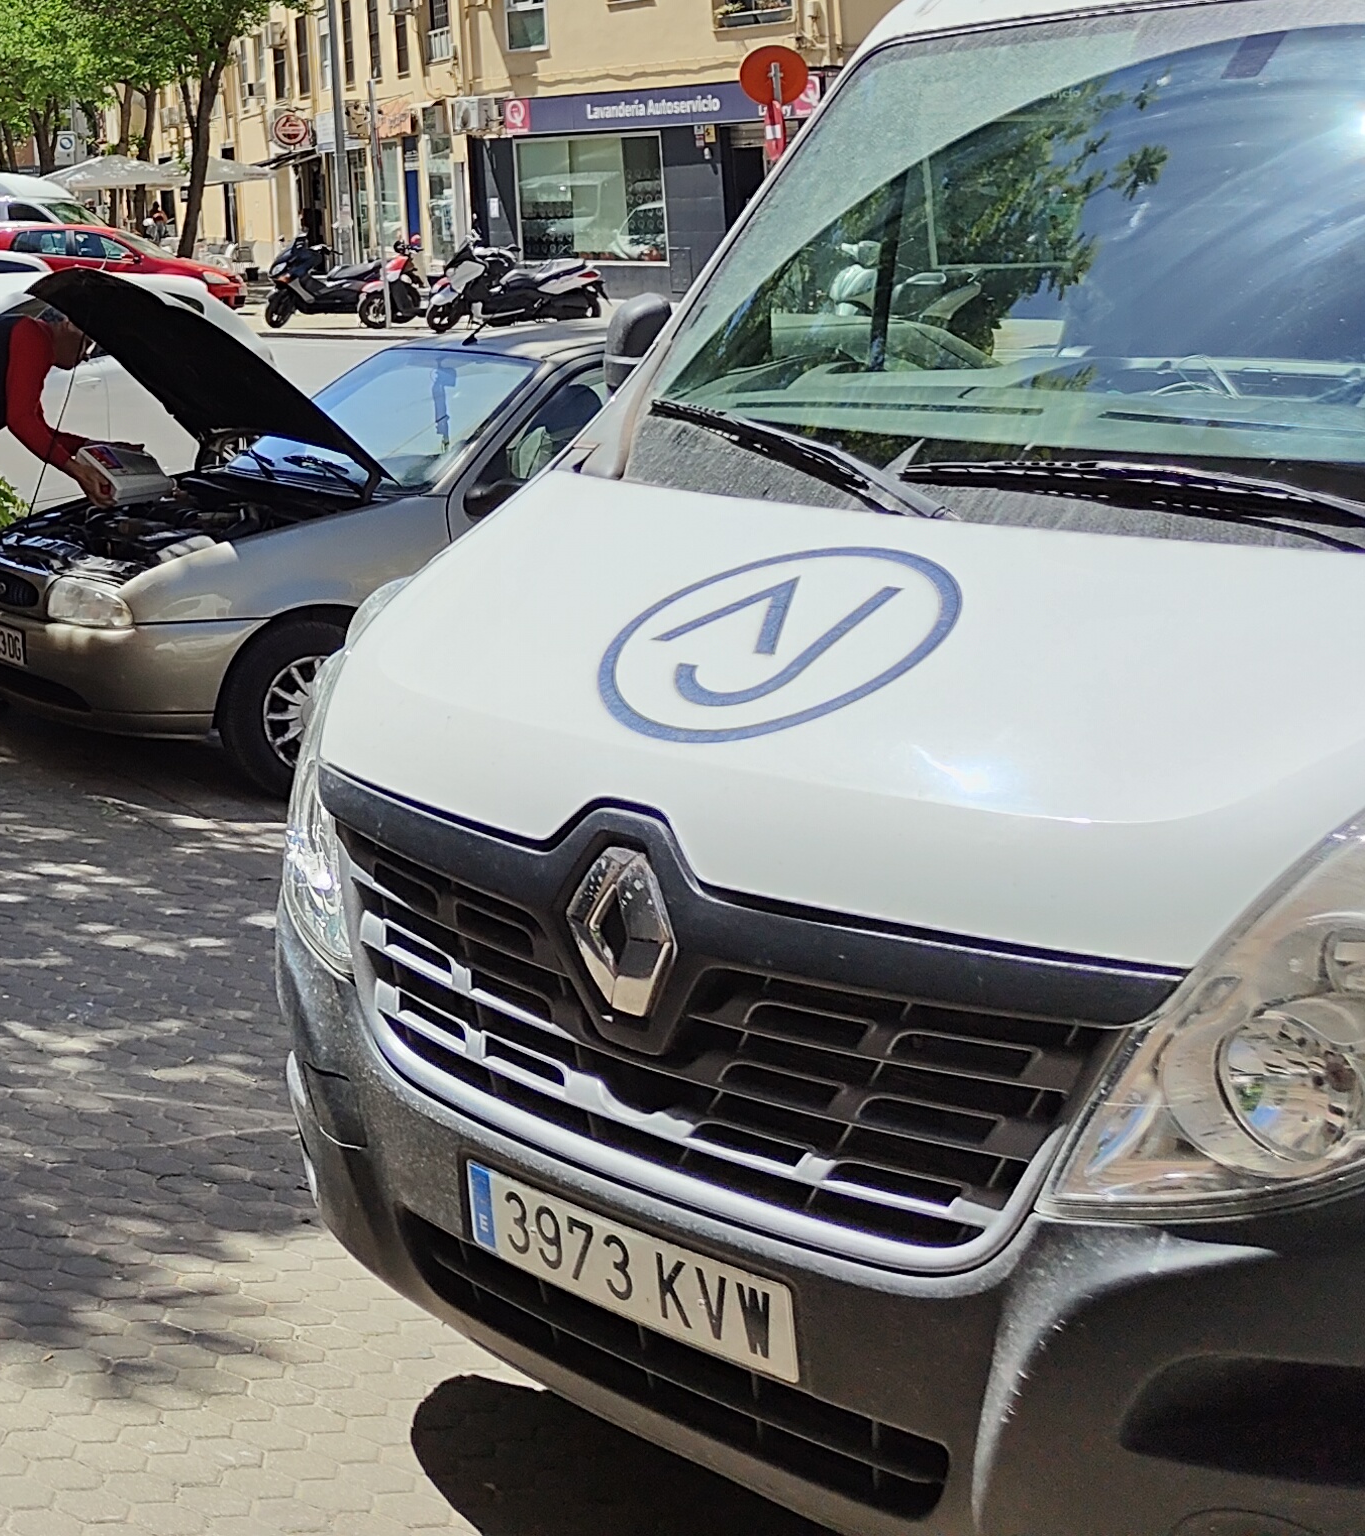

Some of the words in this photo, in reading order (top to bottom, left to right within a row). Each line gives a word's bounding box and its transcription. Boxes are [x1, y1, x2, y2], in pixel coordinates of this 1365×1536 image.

[586, 99, 646, 120] Lavandería
[647, 94, 721, 116] Autoservicio
[504, 1190, 634, 1301] 3973
[655, 1250, 771, 1360] KVW
